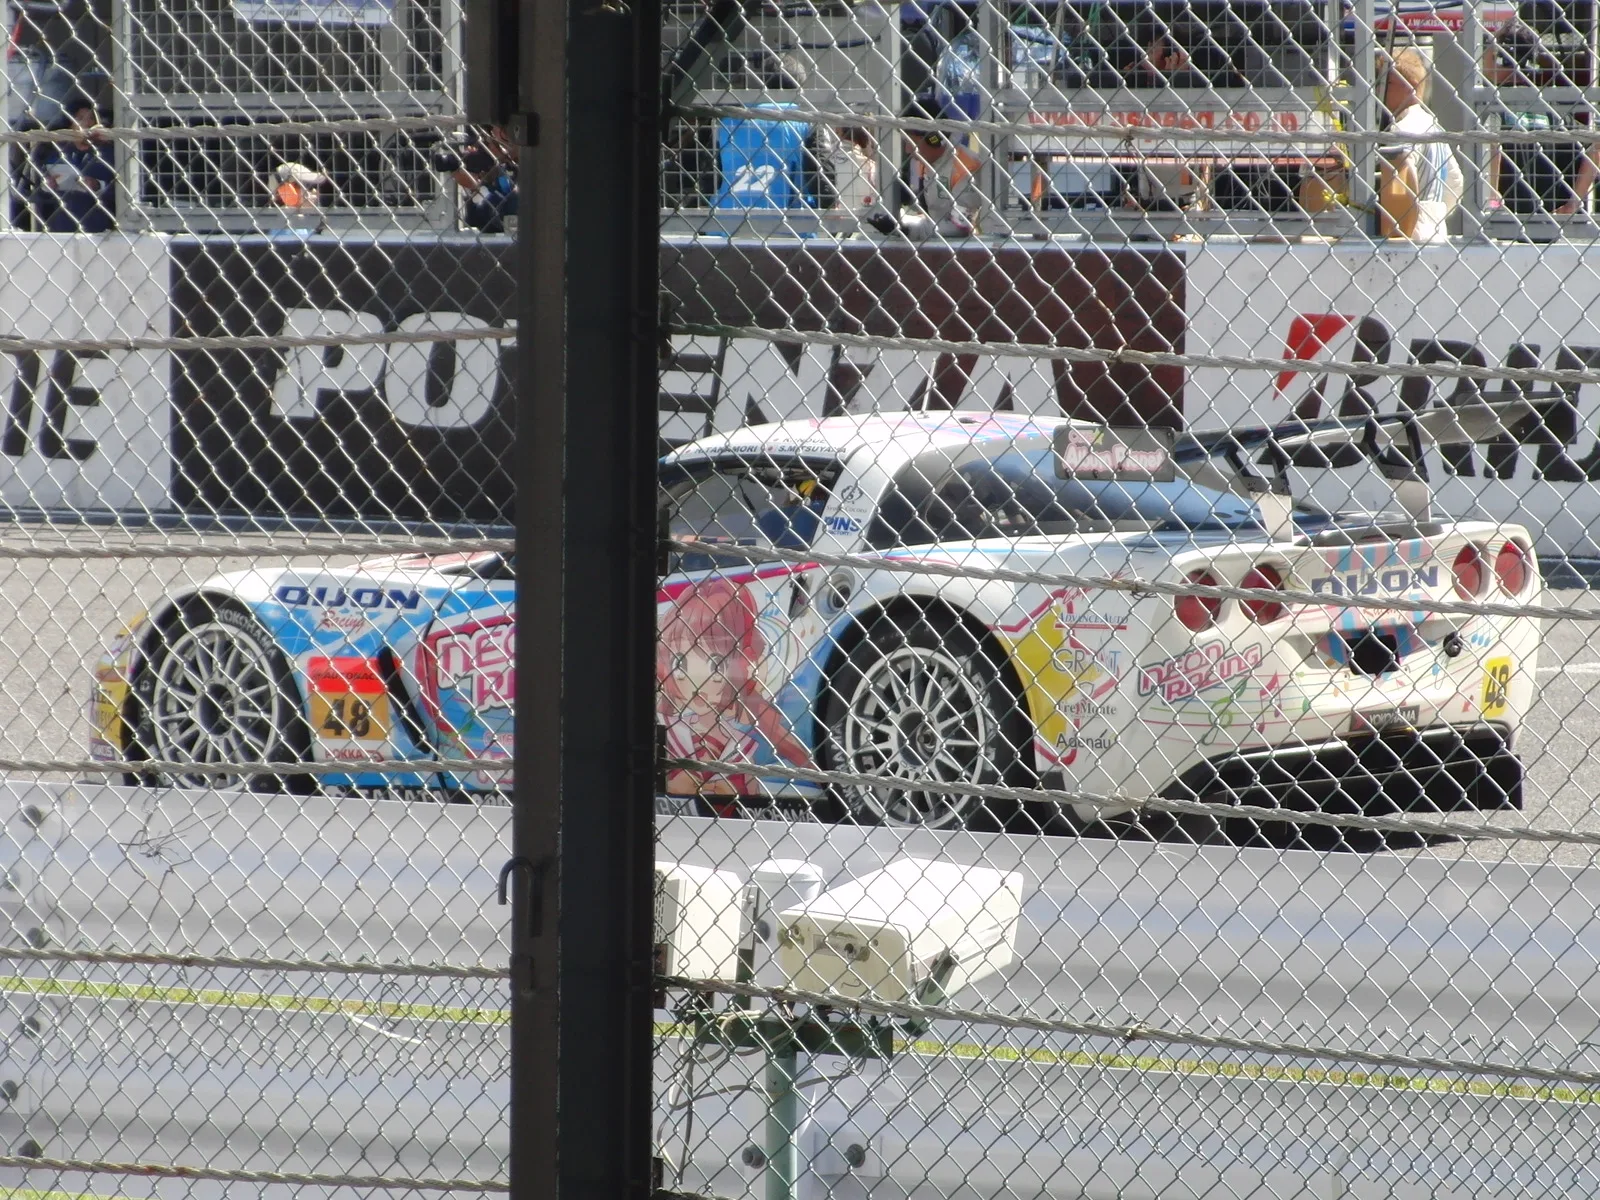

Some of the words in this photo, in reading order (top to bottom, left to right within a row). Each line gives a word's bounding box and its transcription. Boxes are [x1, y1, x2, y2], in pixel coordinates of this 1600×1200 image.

[725, 164, 776, 193] 22
[1485, 664, 1509, 710] 48
[323, 699, 370, 738] 48
